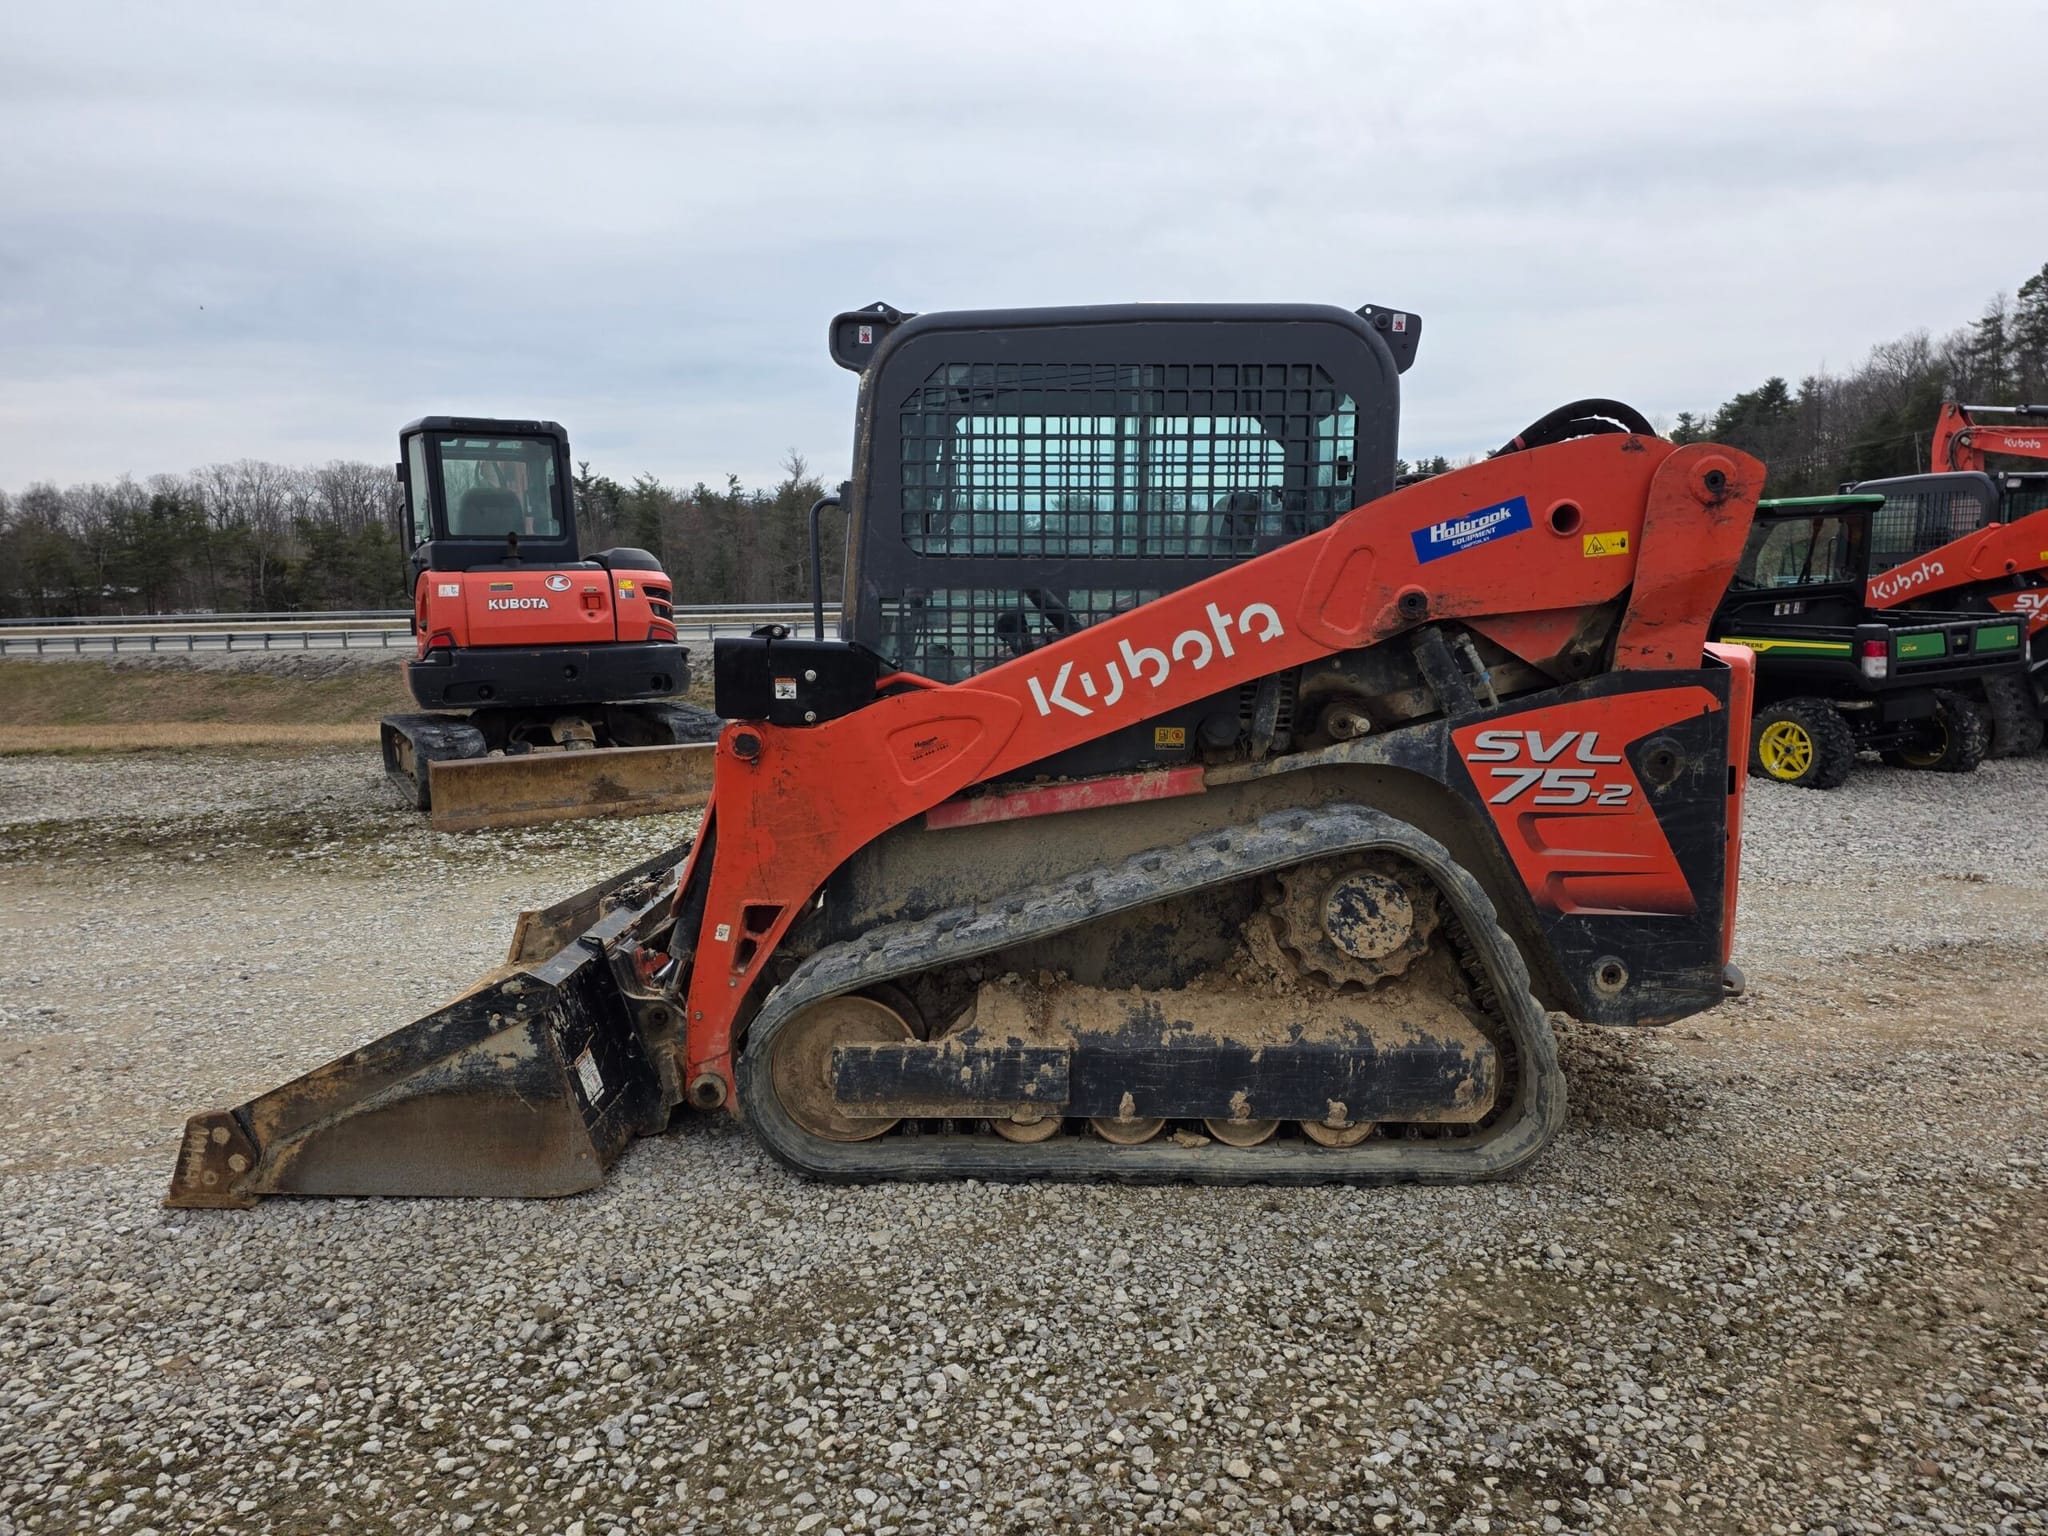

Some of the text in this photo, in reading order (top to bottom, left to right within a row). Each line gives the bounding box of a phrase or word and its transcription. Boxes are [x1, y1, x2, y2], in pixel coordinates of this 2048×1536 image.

[2004, 437, 2041, 448] Kubota
[1430, 507, 1512, 543] Holbrook
[1452, 526, 1496, 546] EQUIPMENT
[1872, 562, 1944, 599] Kubota
[488, 598, 549, 610] KUBOTA
[1027, 602, 1285, 717] Kubota
[1467, 730, 1622, 763] SVL
[1488, 768, 1633, 805] 75-2
